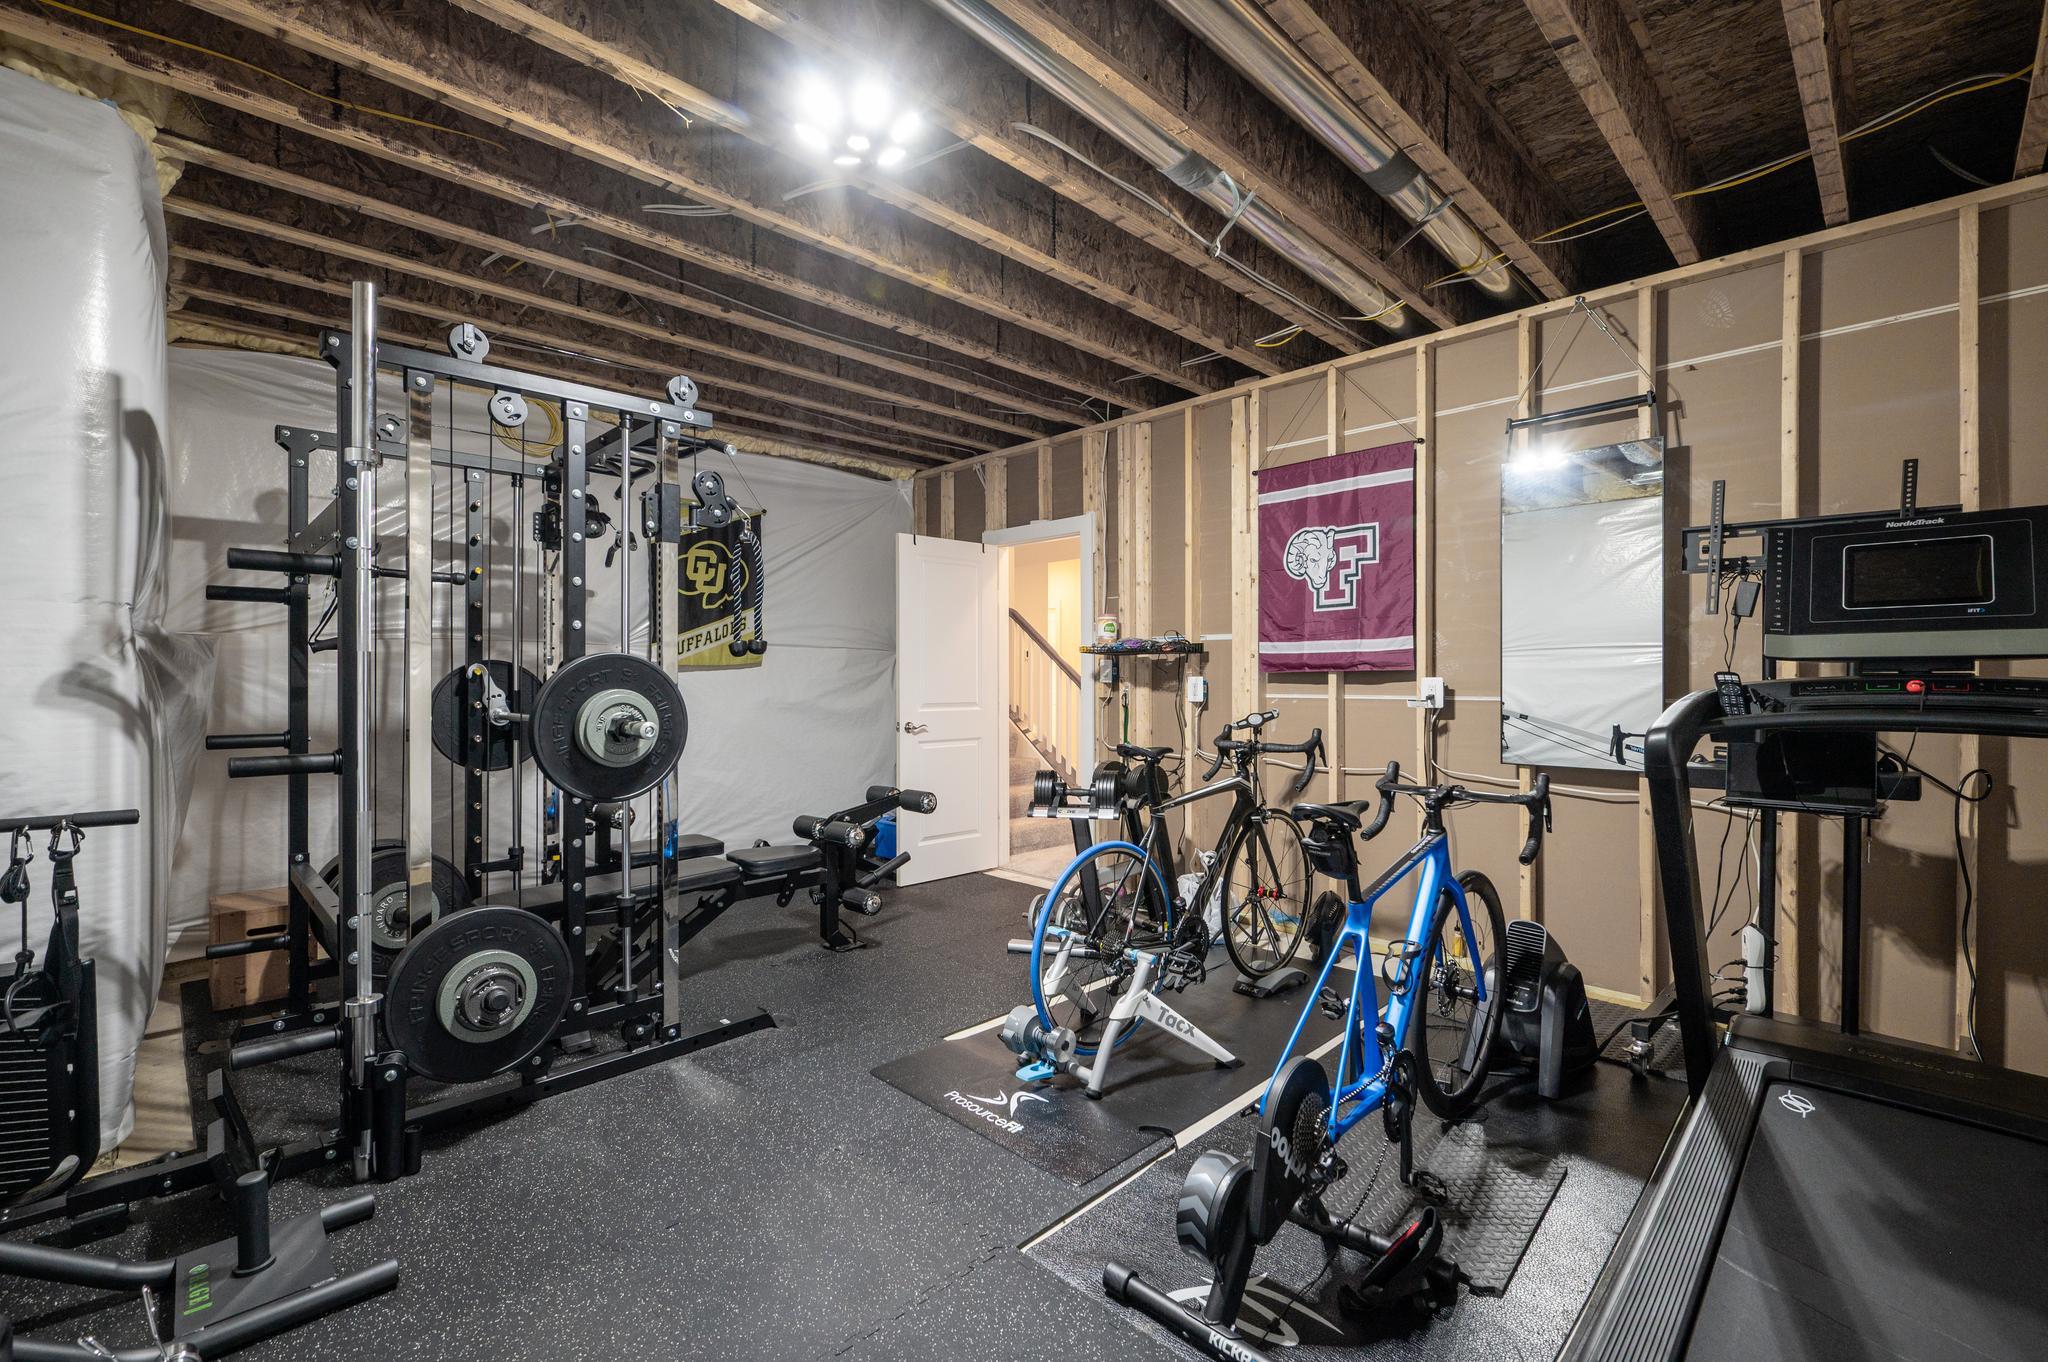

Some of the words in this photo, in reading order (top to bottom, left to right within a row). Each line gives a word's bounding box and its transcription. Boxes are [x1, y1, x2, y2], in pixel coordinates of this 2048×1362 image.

[1885, 517, 1945, 528] NordicTrack
[686, 548, 727, 594] CU
[1313, 522, 1379, 612] F
[450, 926, 526, 953] SPORT
[1158, 1006, 1195, 1038] Tacx
